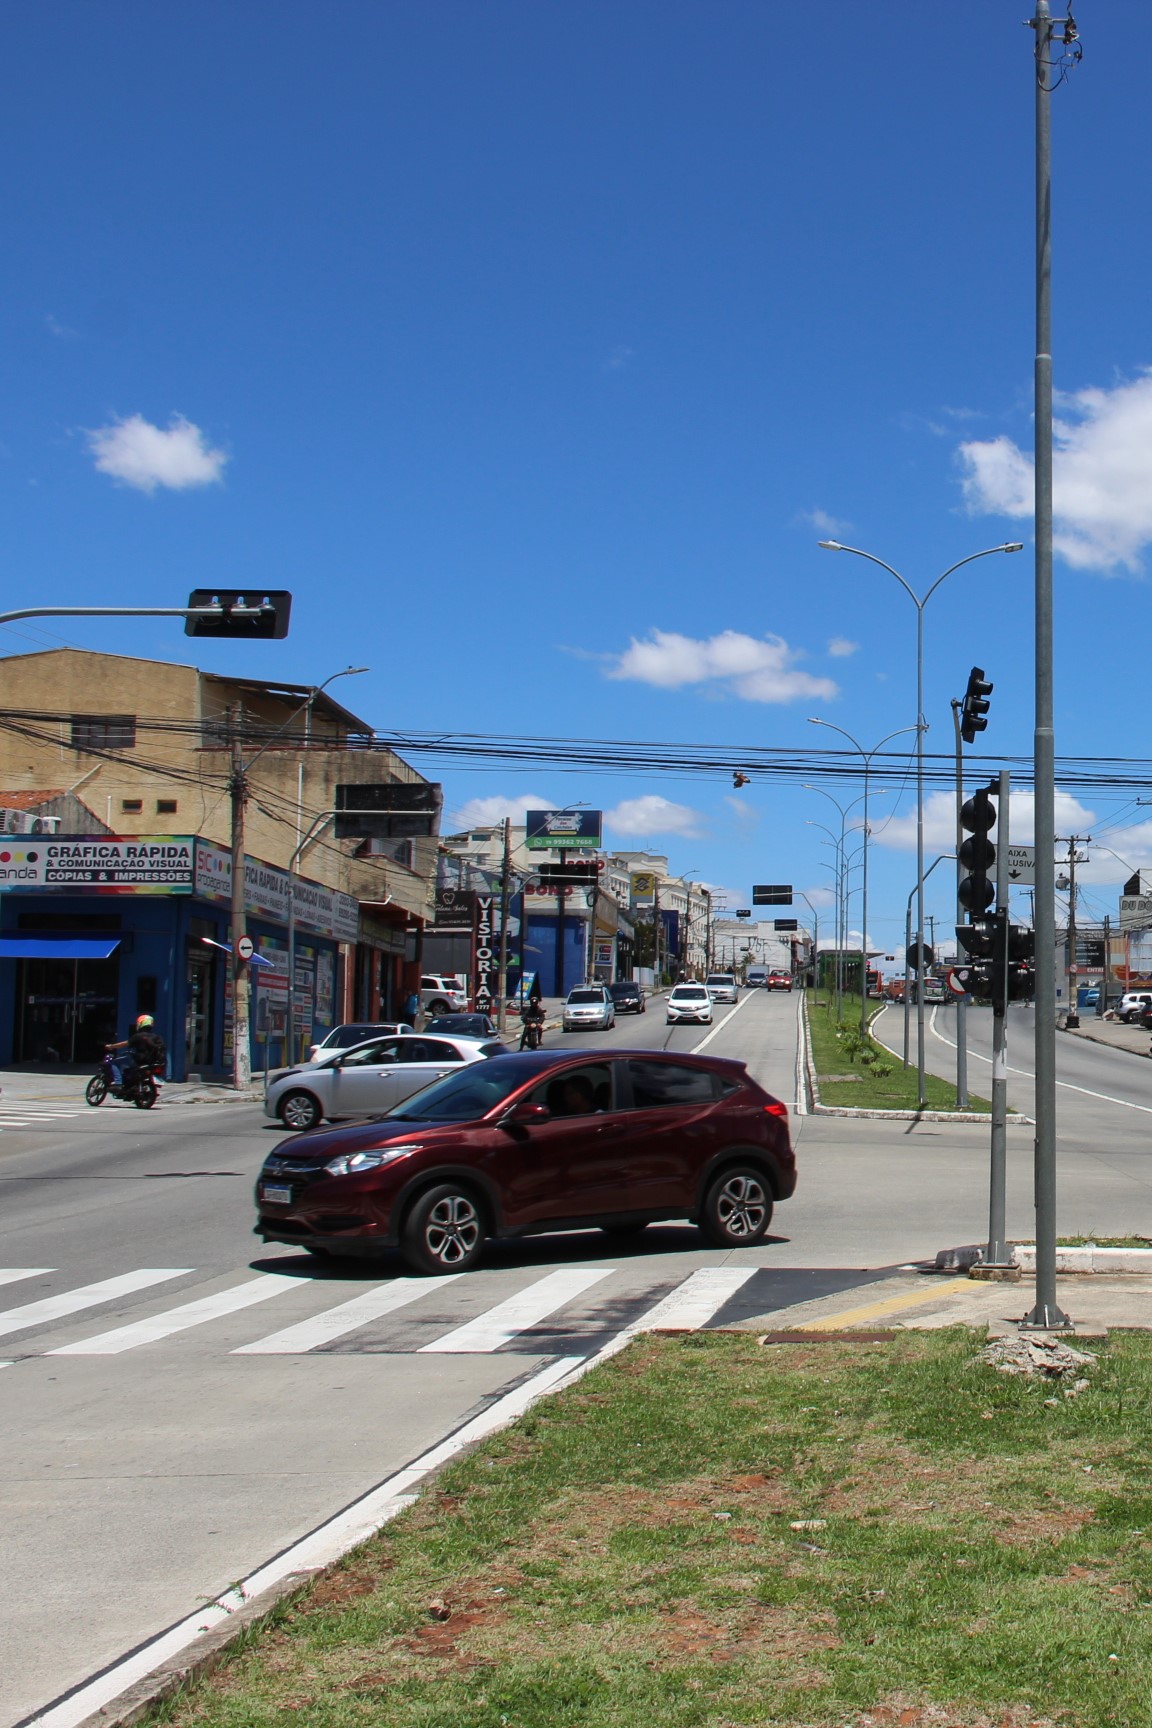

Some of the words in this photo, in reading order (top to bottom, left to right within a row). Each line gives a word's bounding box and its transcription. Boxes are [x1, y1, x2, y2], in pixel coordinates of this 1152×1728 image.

[47, 843, 121, 859] GRÁFICA
[126, 843, 190, 859] RÁPIDA
[1008, 849, 1028, 858] AIXA
[46, 860, 54, 868] &
[58, 858, 145, 870] COMUNICAÇÃO
[149, 859, 190, 868] VISUAL
[47, 869, 92, 881] CÓPIAS
[98, 872, 108, 881] &
[114, 870, 191, 881] IMPRESSÕES
[476, 897, 492, 997] VISTORIA
